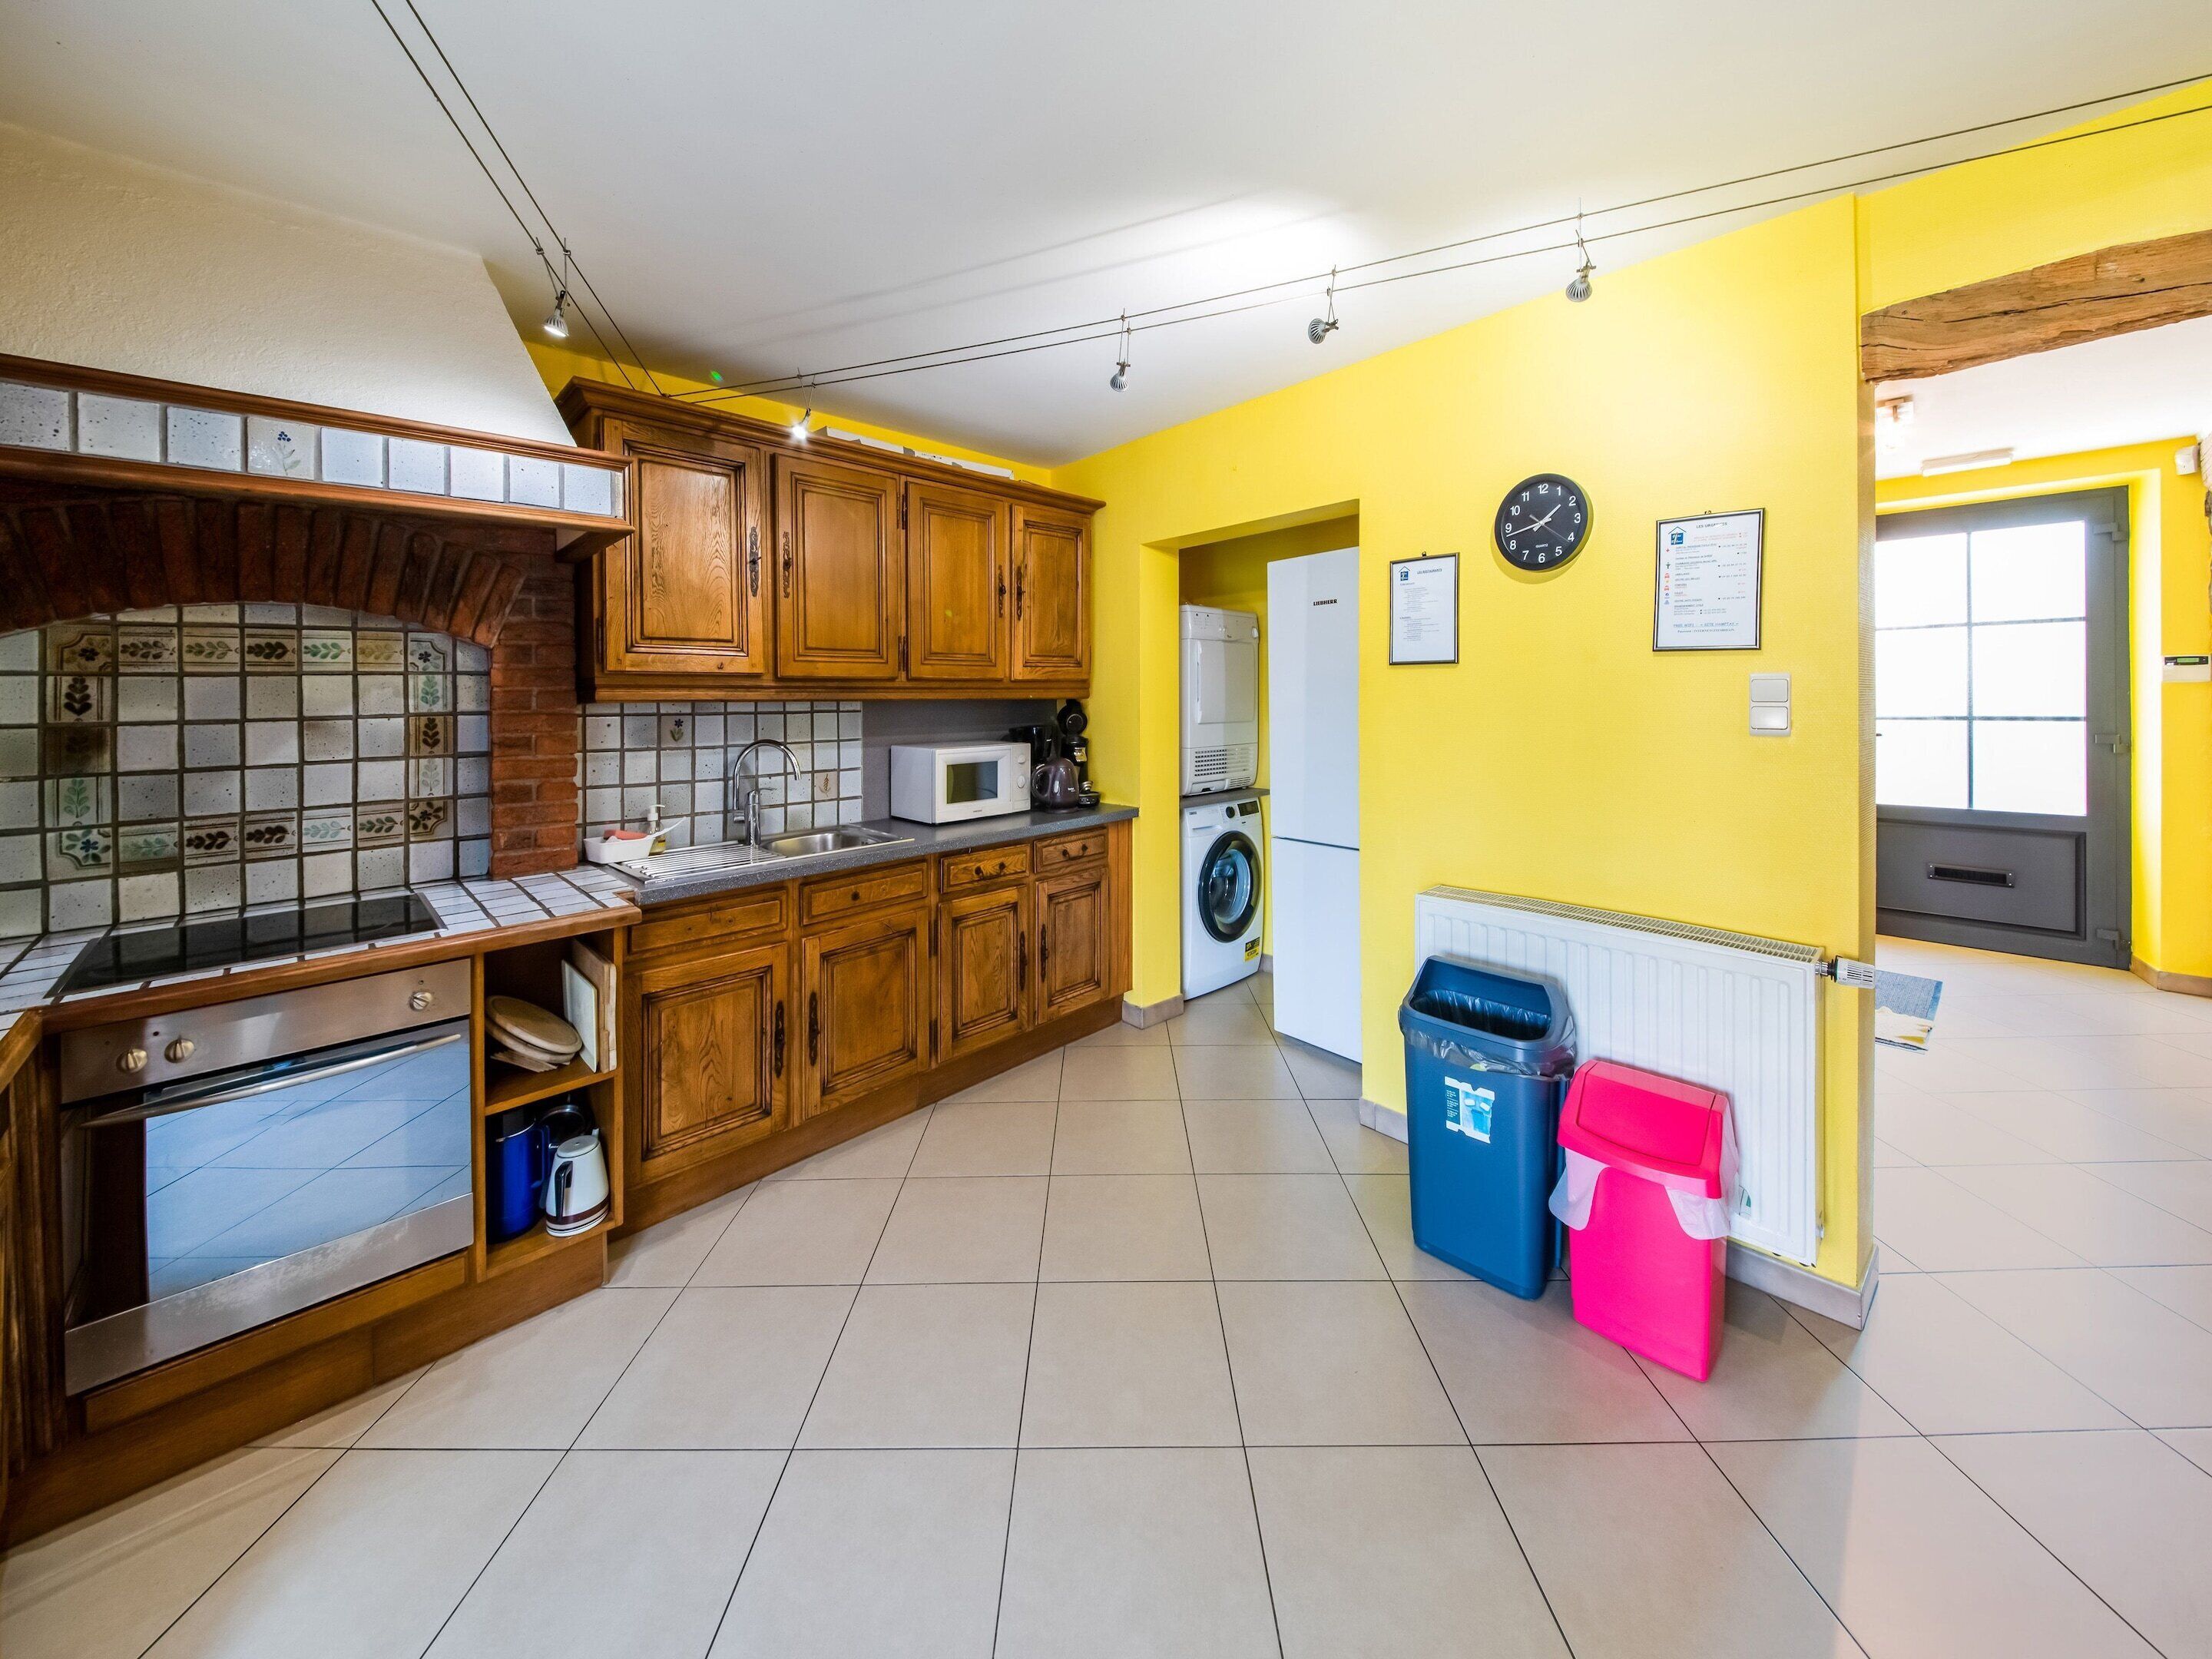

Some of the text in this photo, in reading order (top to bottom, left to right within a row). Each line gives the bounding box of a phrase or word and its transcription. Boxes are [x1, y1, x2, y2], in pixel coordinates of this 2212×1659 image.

[1538, 483, 1548, 494] 12
[1556, 485, 1561, 495] 1
[1522, 492, 1529, 502] 11
[1568, 495, 1576, 506] 2
[1510, 505, 1520, 515] 10
[1574, 513, 1581, 523] 3
[1505, 523, 1512, 533] 9
[1568, 532, 1575, 541] 4
[1509, 540, 1516, 550] 8
[1522, 550, 1529, 560] 7
[1555, 546, 1562, 556] 5
[1538, 553, 1545, 563] 6
